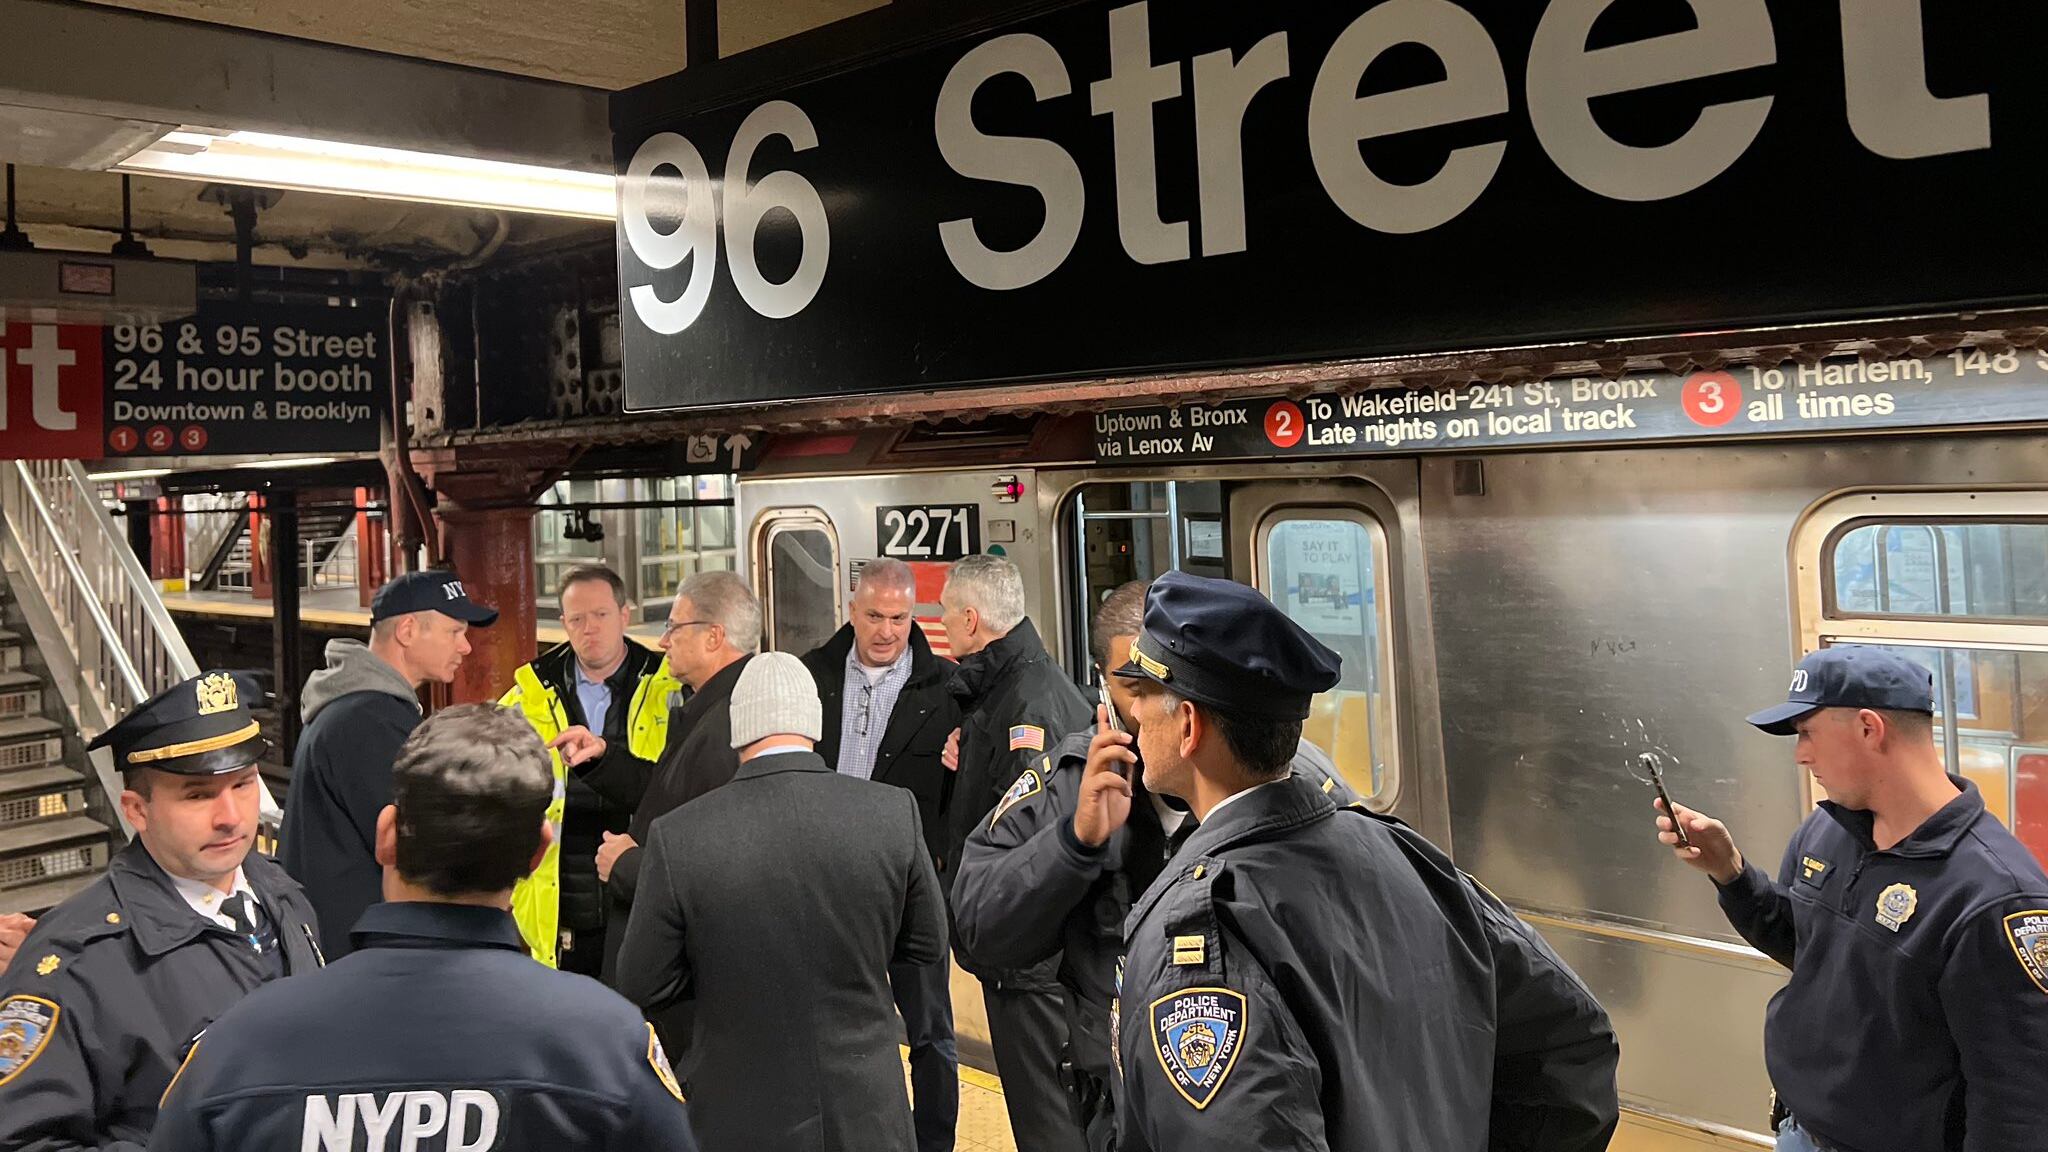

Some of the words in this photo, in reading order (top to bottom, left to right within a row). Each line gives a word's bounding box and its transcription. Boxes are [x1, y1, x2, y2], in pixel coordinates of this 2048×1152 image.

[623, 101, 830, 334] 96
[113, 322, 164, 354] 96
[176, 323, 204, 354] &
[216, 325, 262, 356] 95
[272, 326, 376, 359] Street
[0, 308, 77, 430] t
[114, 359, 163, 391] 24
[176, 359, 264, 391] hour
[274, 361, 372, 391] booth
[1798, 357, 1933, 388] Harlem,
[1948, 347, 2021, 378] 148
[113, 400, 245, 421] Downtown
[252, 400, 268, 420] &
[275, 401, 371, 423] Brooklyn
[1306, 398, 1332, 421] To
[1524, 381, 1561, 408] St,
[1572, 377, 1657, 402] Bronx
[1698, 381, 1725, 413] 3
[1747, 393, 1784, 422] all
[1797, 390, 1895, 420] times
[1095, 414, 1162, 436] Uptown
[1169, 408, 1183, 429] &
[1190, 406, 1248, 427] Bronx
[1275, 410, 1293, 437] 2
[1307, 423, 1356, 446] Late
[1365, 418, 1437, 446] nights
[1446, 418, 1480, 439] on
[1488, 408, 1551, 436] local
[1562, 403, 1637, 432] track
[152, 431, 165, 446] 2
[188, 430, 200, 445] 3
[1097, 438, 1122, 457] via
[1128, 434, 1184, 456] Lenox
[1191, 431, 1214, 453] Av
[884, 508, 970, 556] 2271
[1302, 541, 1324, 551] SAY
[1328, 541, 1338, 551] IT
[1304, 553, 1319, 564] TO
[1321, 553, 1352, 564] PLAY
[1161, 1007, 1236, 1032] DEPARTMENT
[1174, 995, 1219, 1012] POLICE
[1161, 1044, 1178, 1070] CITY
[1176, 1068, 1190, 1086] OF
[1204, 1062, 1222, 1088] NEW
[1219, 1030, 1237, 1060] YORK
[301, 1089, 500, 1152] NYPD
